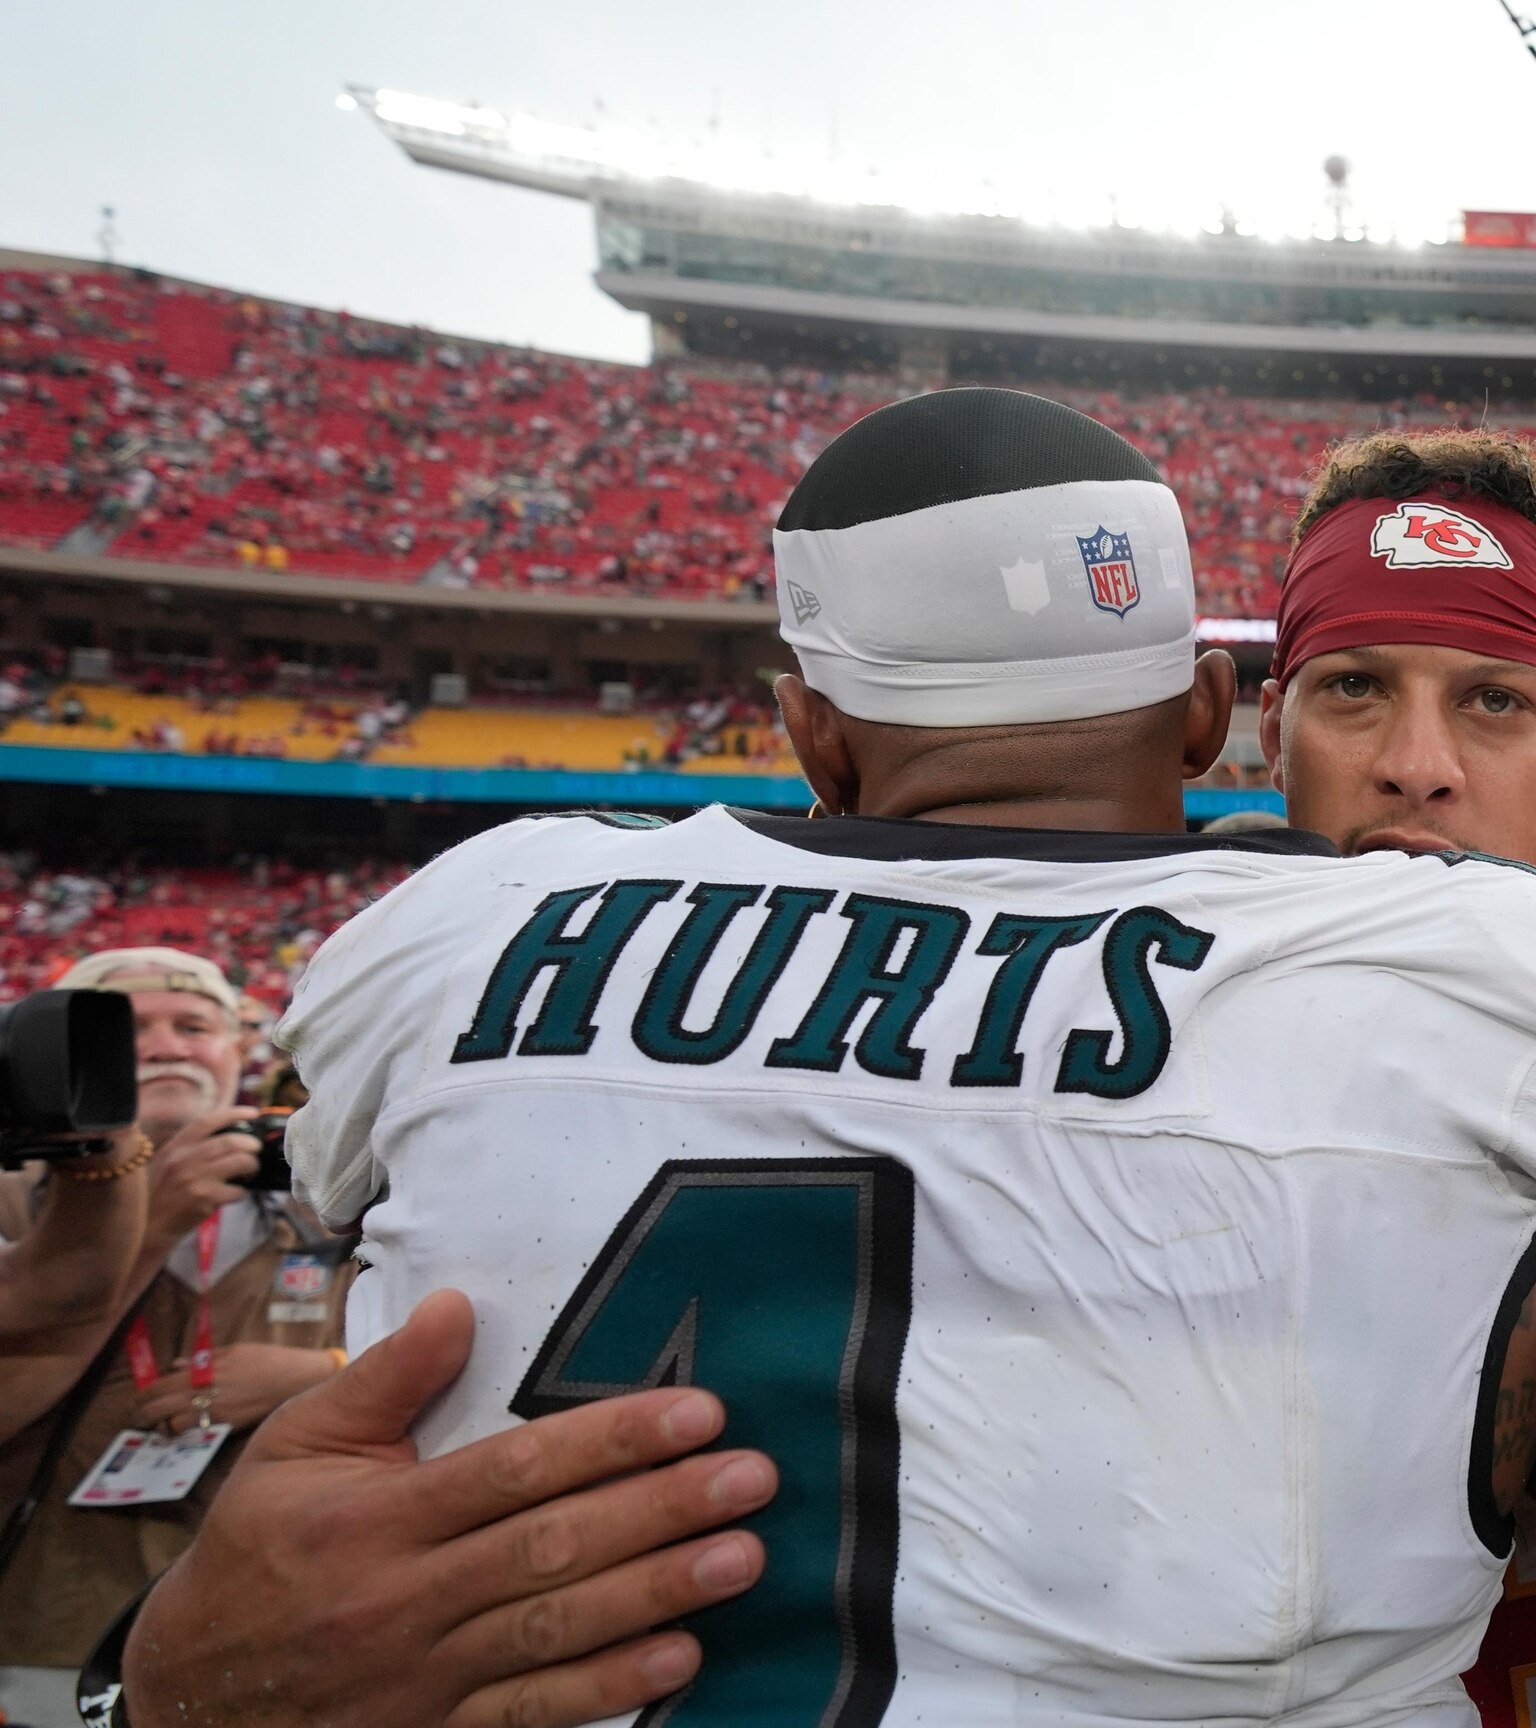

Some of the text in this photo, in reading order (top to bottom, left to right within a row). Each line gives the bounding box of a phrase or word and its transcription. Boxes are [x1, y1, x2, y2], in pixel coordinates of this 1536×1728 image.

[1403, 515, 1482, 558] KC
[1091, 563, 1137, 607] NFL
[448, 878, 1216, 1100] HURTS
